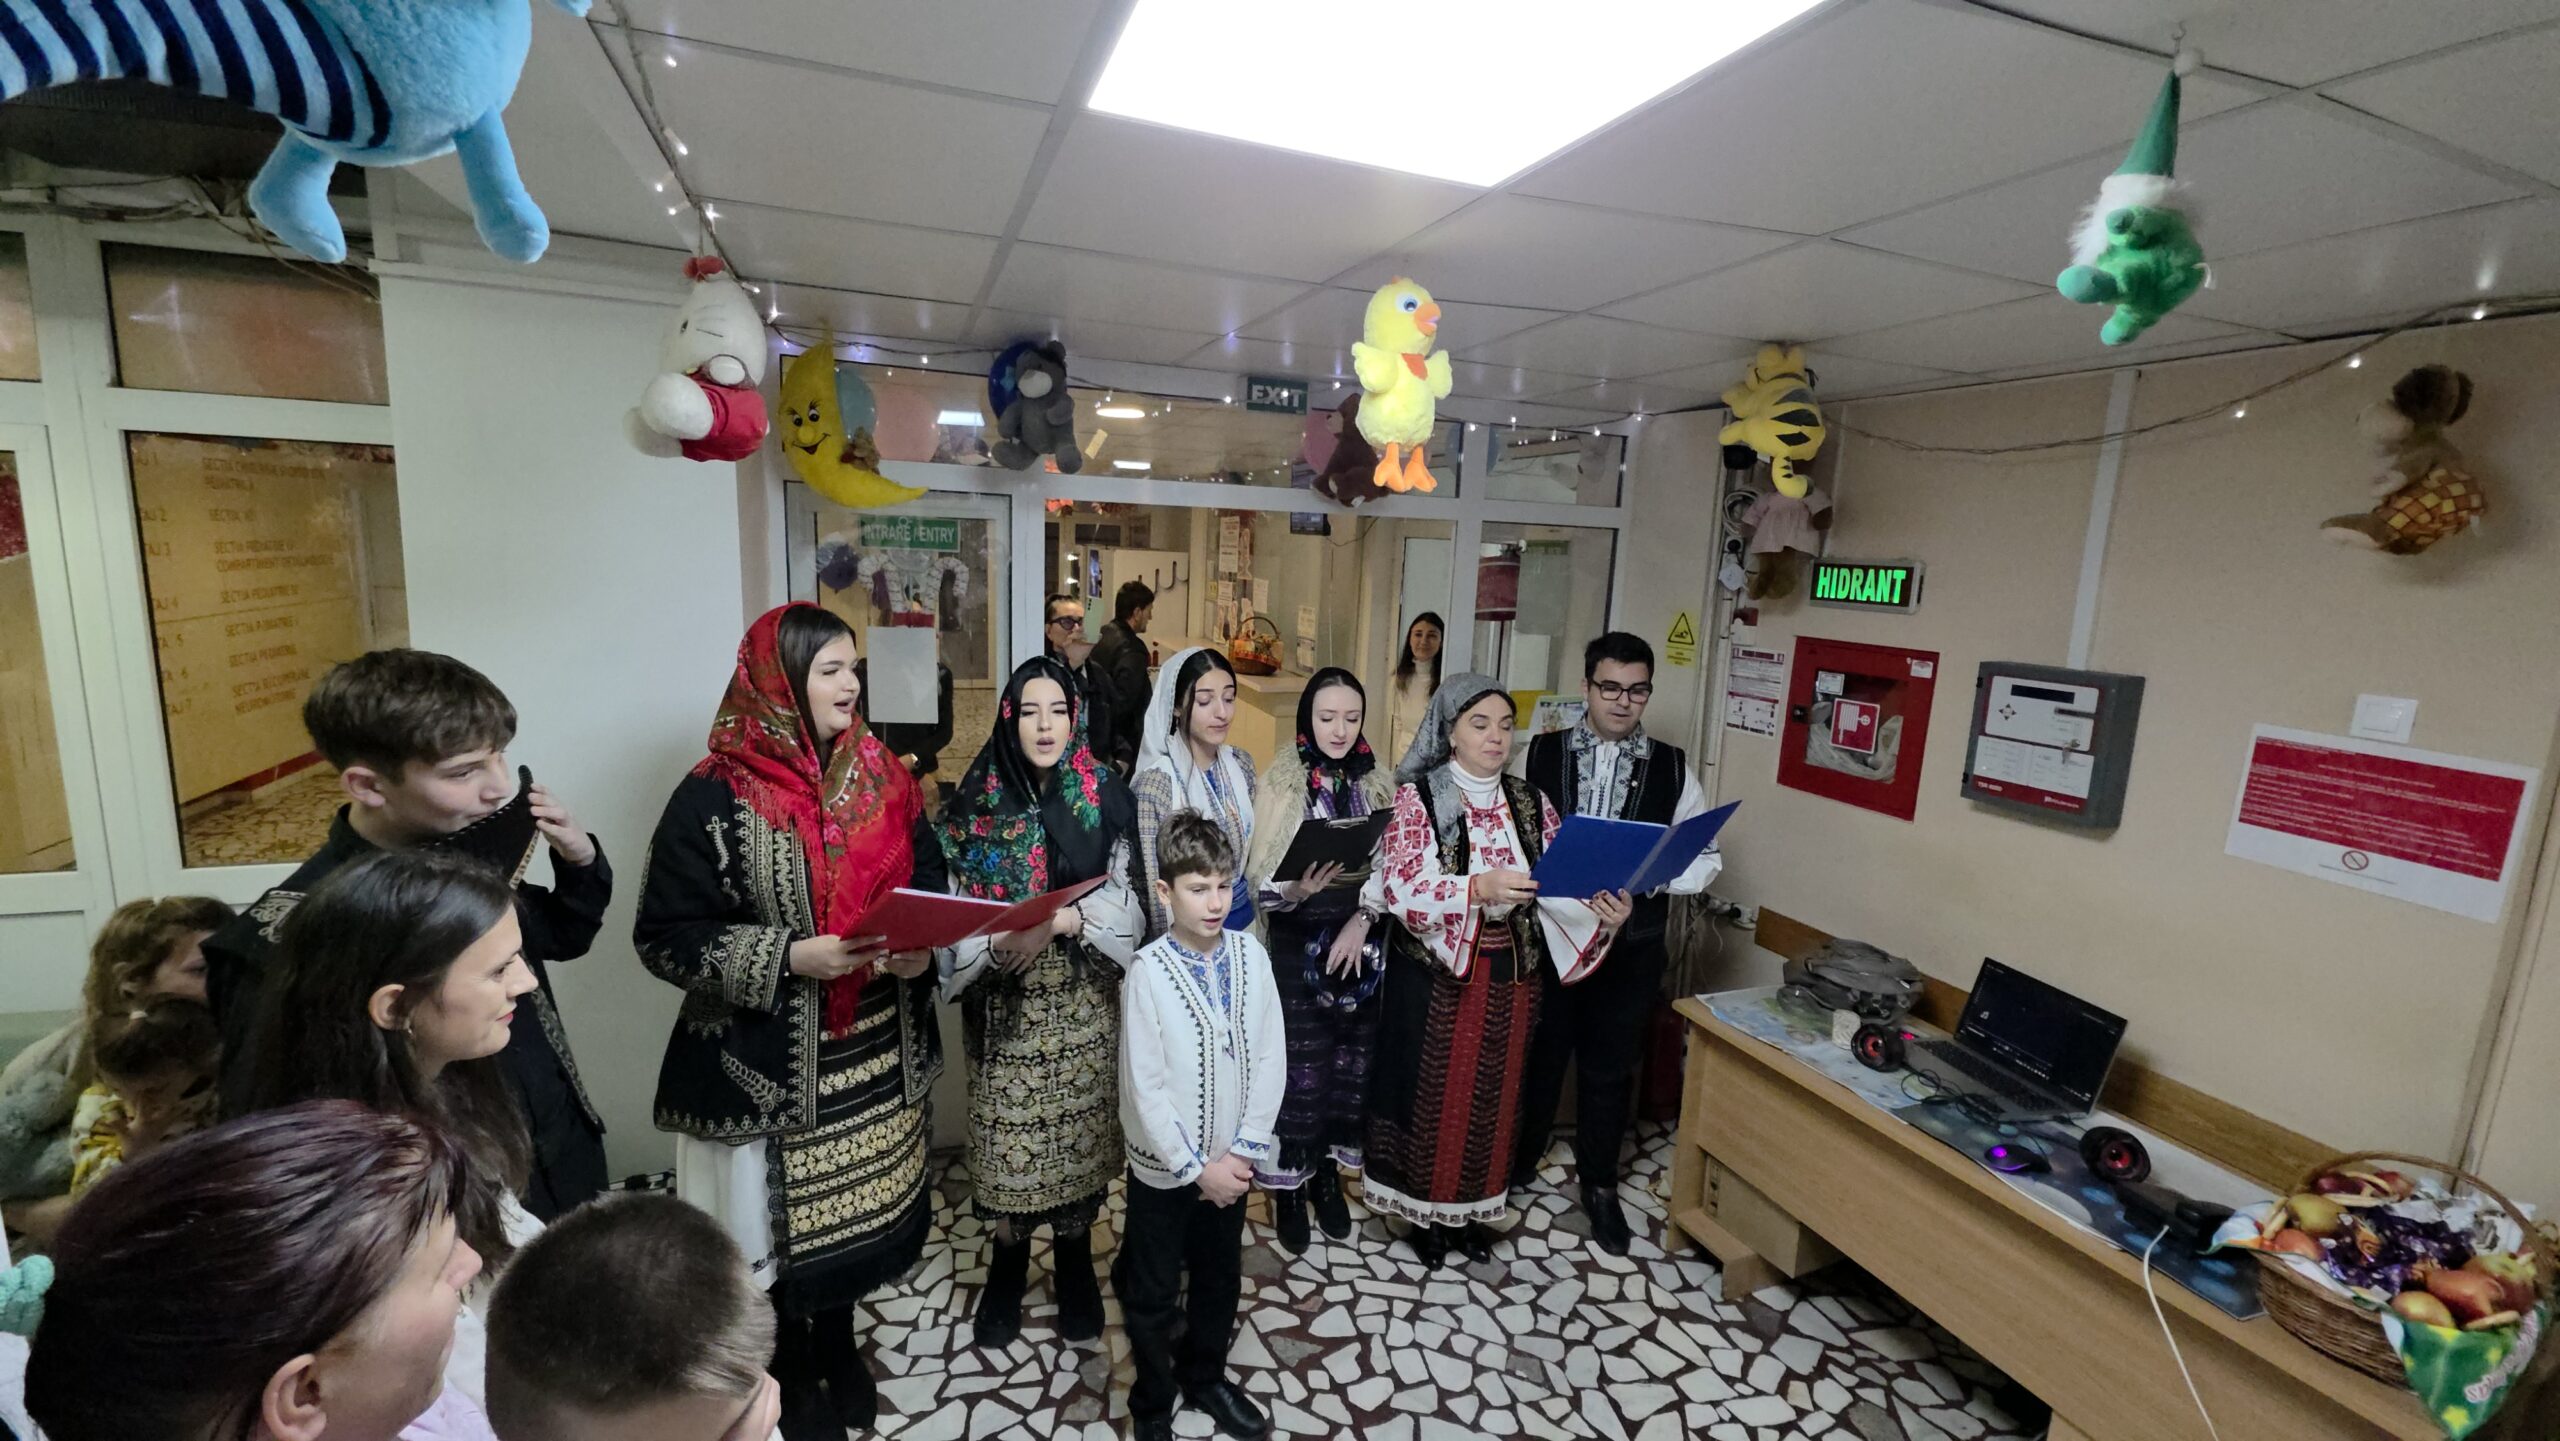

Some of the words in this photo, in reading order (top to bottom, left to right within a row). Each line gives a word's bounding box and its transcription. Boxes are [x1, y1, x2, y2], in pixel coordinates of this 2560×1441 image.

[1251, 384, 1302, 408] EXIT
[863, 524, 911, 541] INTRARE
[919, 526, 955, 544] ENTRY
[1816, 566, 1907, 604] HIDRANT
